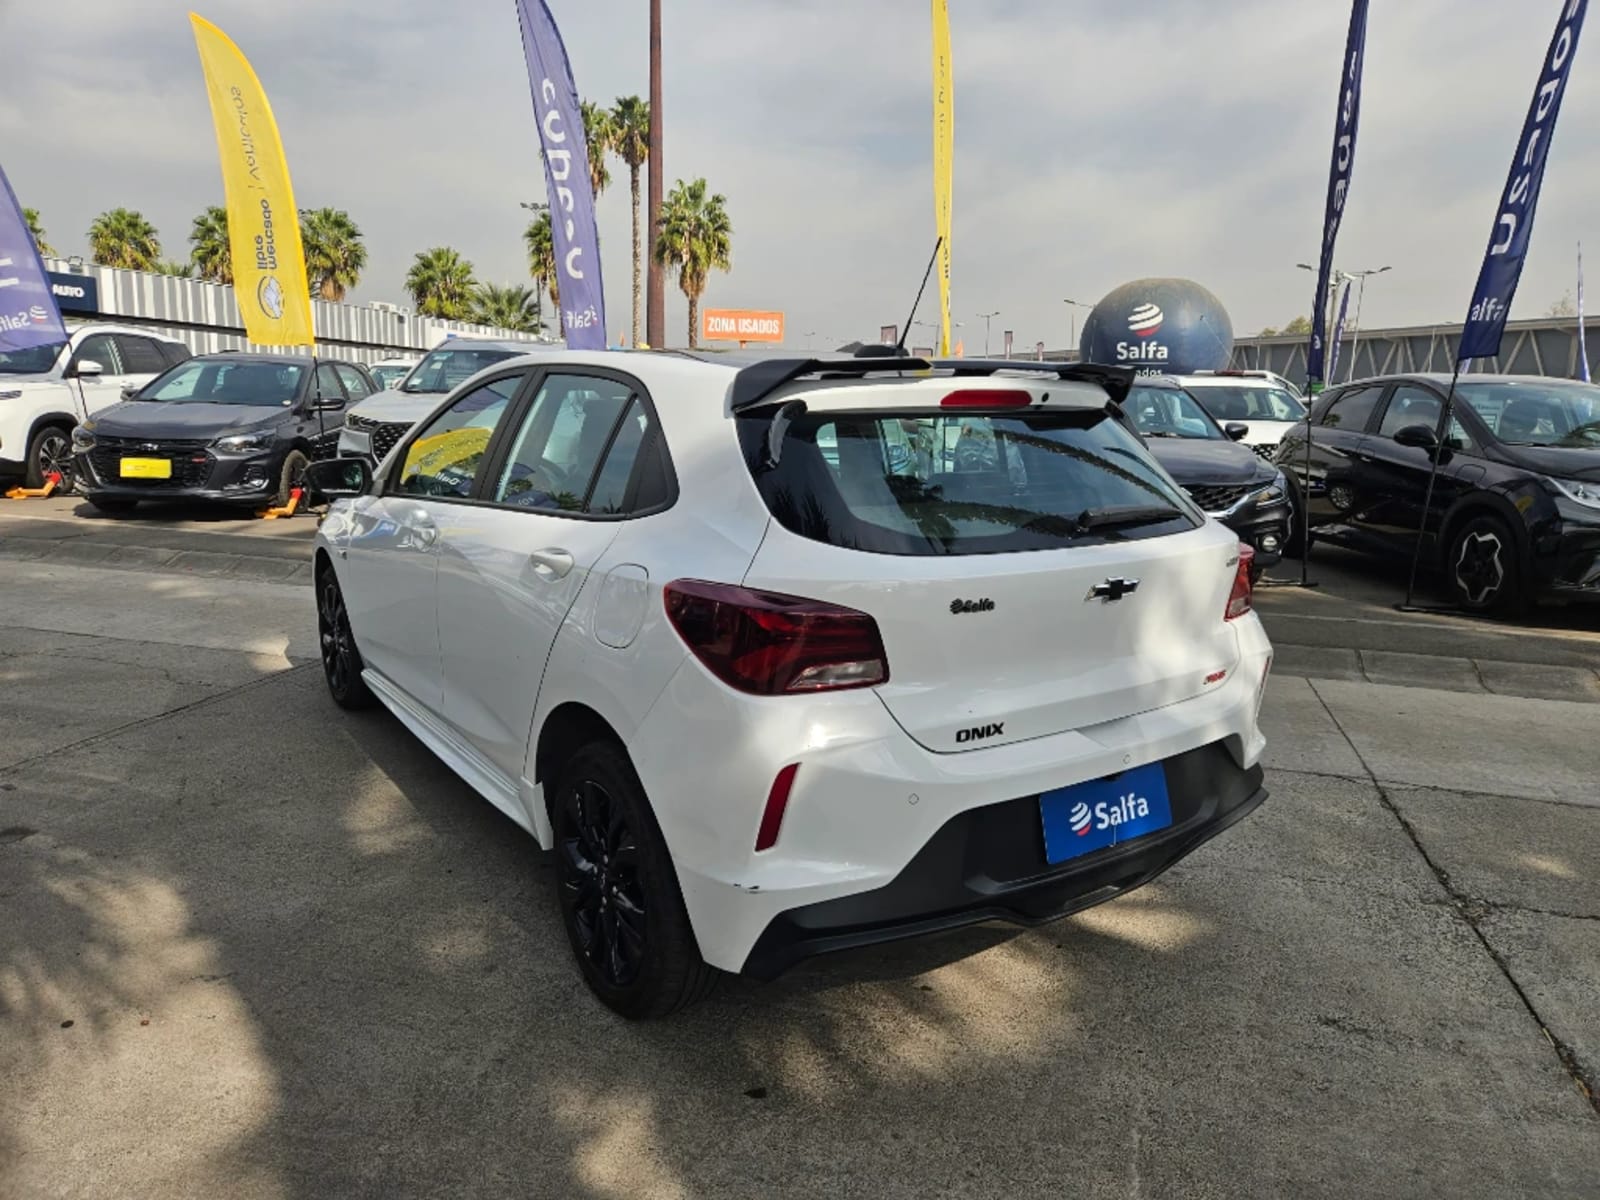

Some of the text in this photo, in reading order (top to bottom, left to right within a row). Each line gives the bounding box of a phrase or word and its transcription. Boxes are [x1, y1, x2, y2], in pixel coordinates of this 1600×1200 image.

[1471, 297, 1504, 321] alf
[708, 316, 780, 334] ZONA USADOS
[1116, 340, 1168, 360] Salfa
[1135, 367, 1163, 378] ados
[955, 721, 1004, 743] ONIX
[1095, 792, 1149, 830] Salfa
